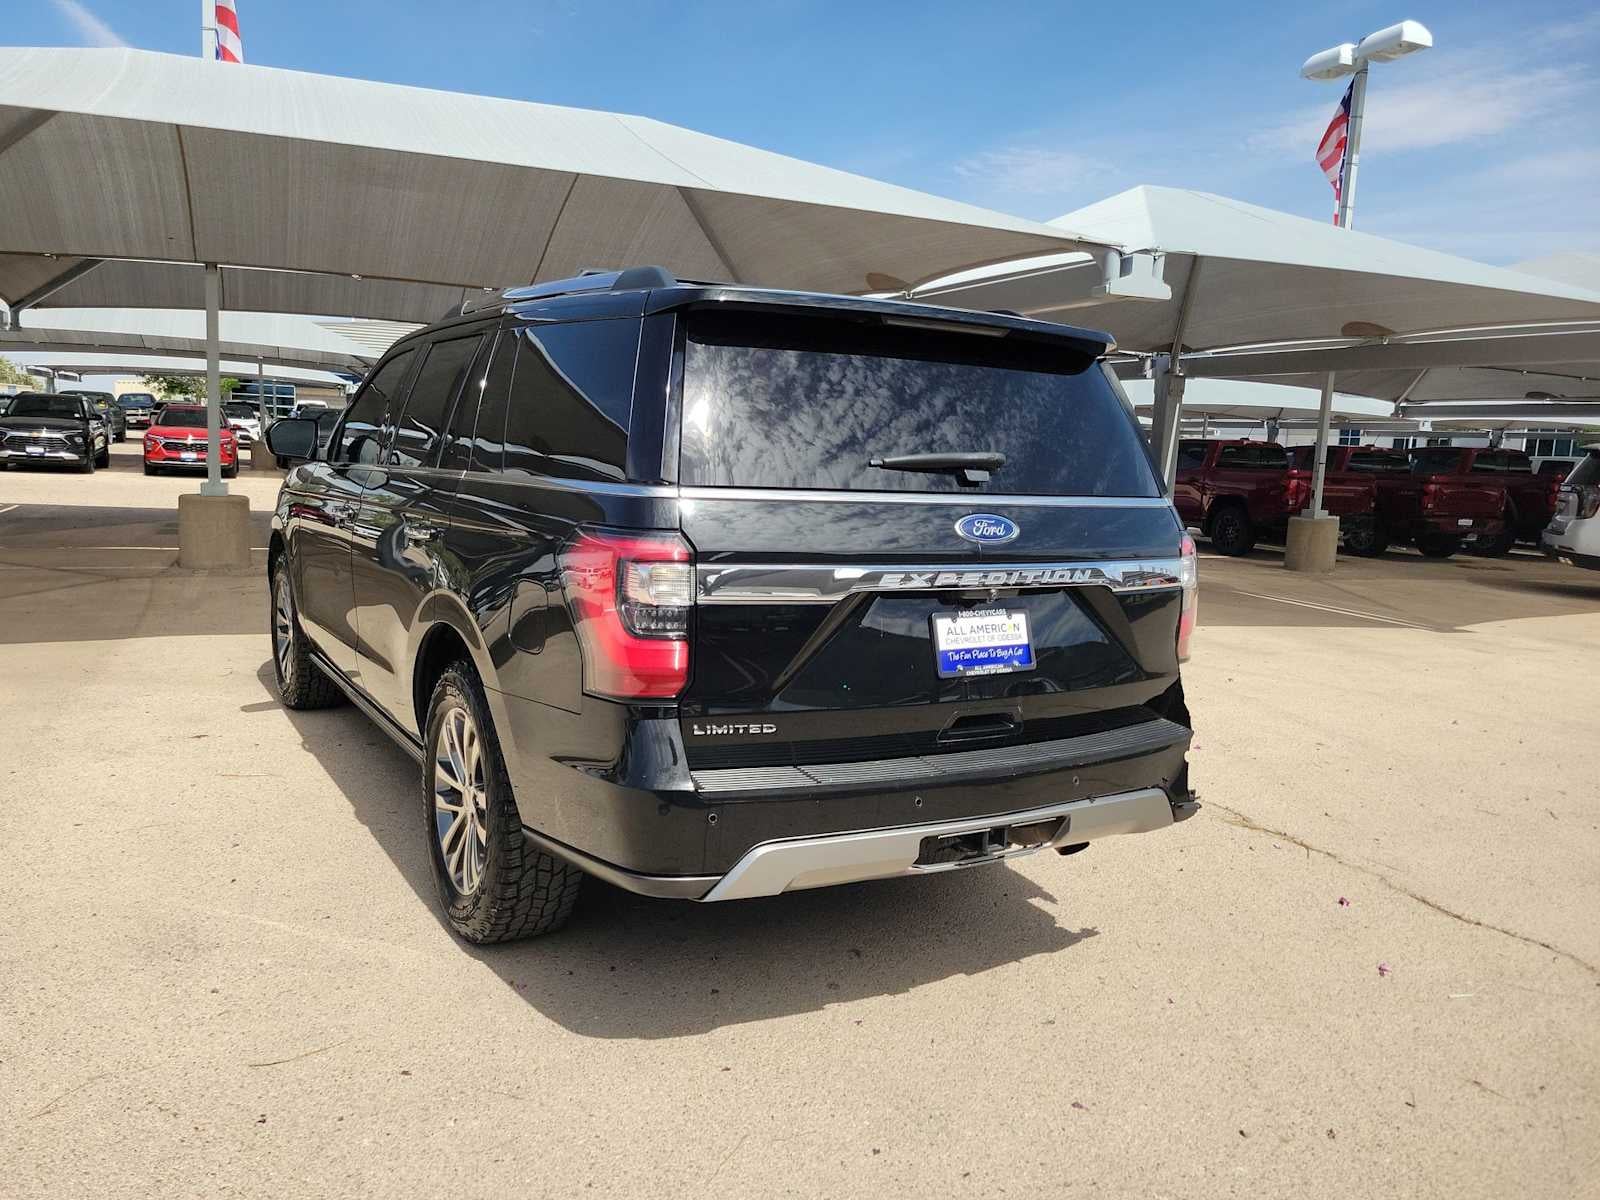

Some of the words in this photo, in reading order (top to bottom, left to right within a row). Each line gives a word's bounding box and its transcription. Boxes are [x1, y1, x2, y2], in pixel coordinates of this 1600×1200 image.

[972, 519, 1005, 536] Ford
[879, 569, 1092, 588] EXPEDITION
[946, 626, 967, 635] ALL
[970, 623, 1020, 634] AMERICAN
[948, 652, 959, 662] The
[972, 649, 988, 659] Place
[693, 724, 777, 736] LIMITED
